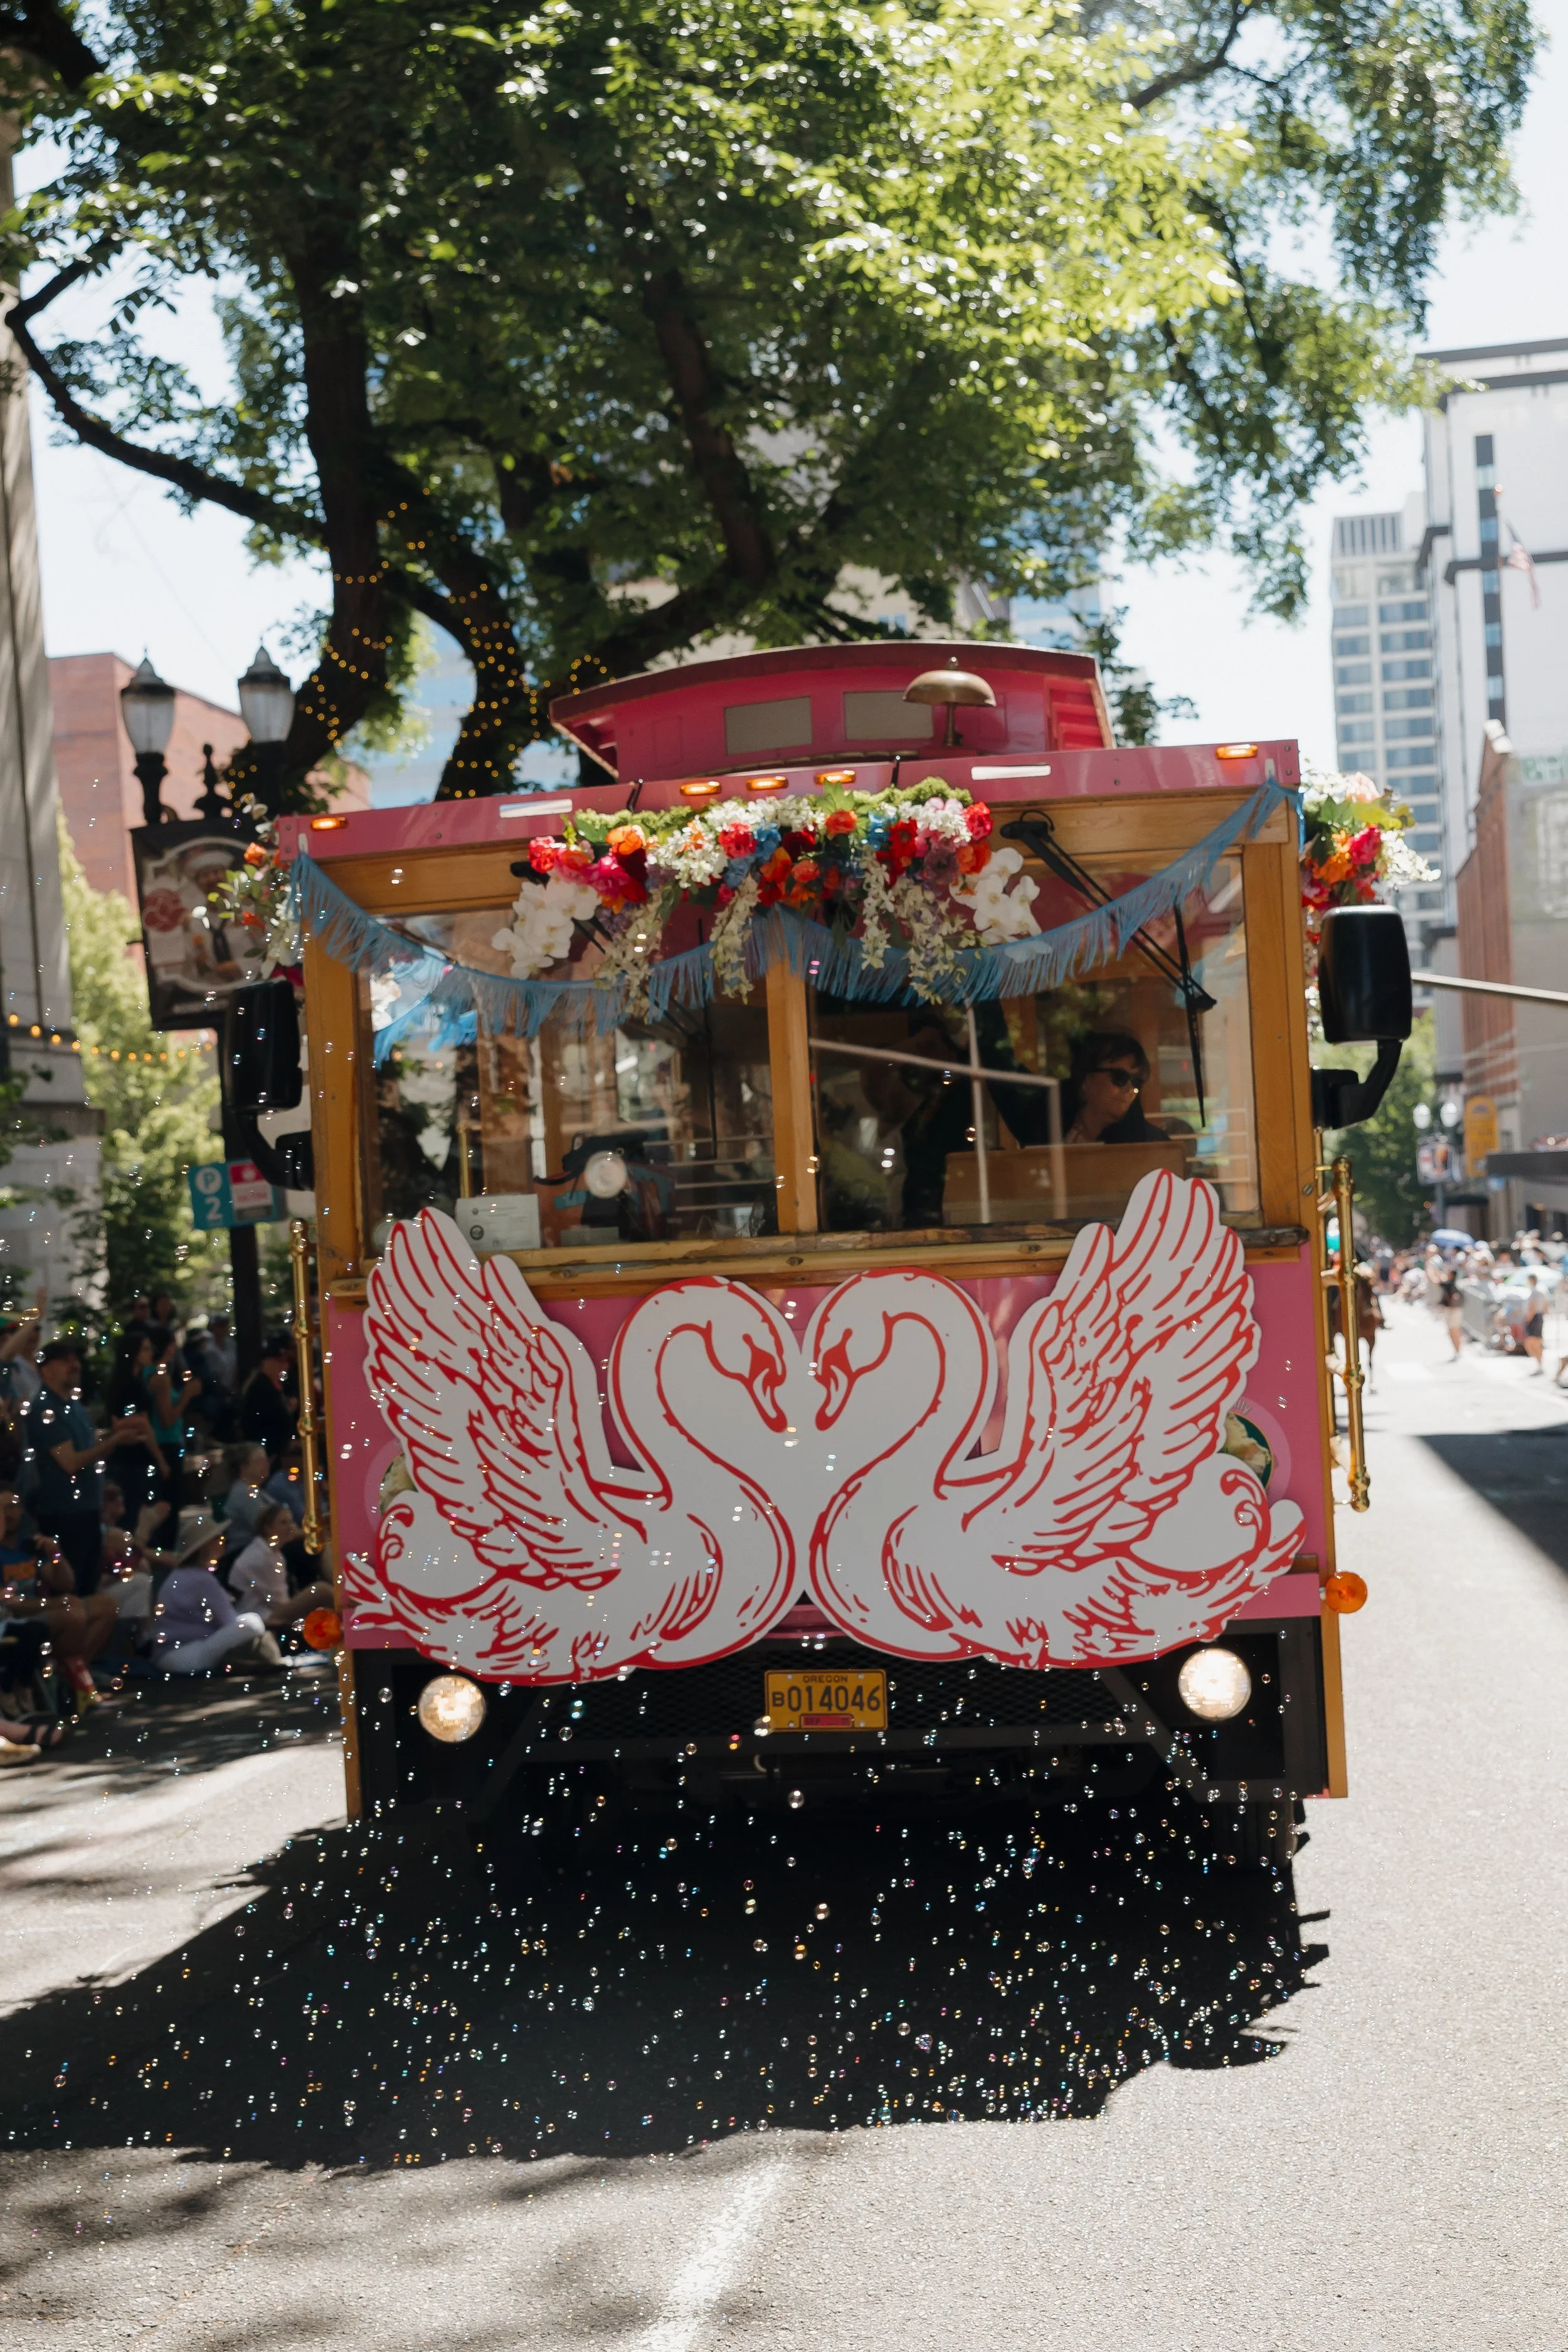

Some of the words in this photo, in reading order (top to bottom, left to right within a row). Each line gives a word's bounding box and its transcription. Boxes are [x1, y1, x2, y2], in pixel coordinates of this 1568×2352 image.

[203, 1172, 216, 1190] P
[205, 1196, 222, 1220] 2
[772, 1685, 881, 1712] B014046
